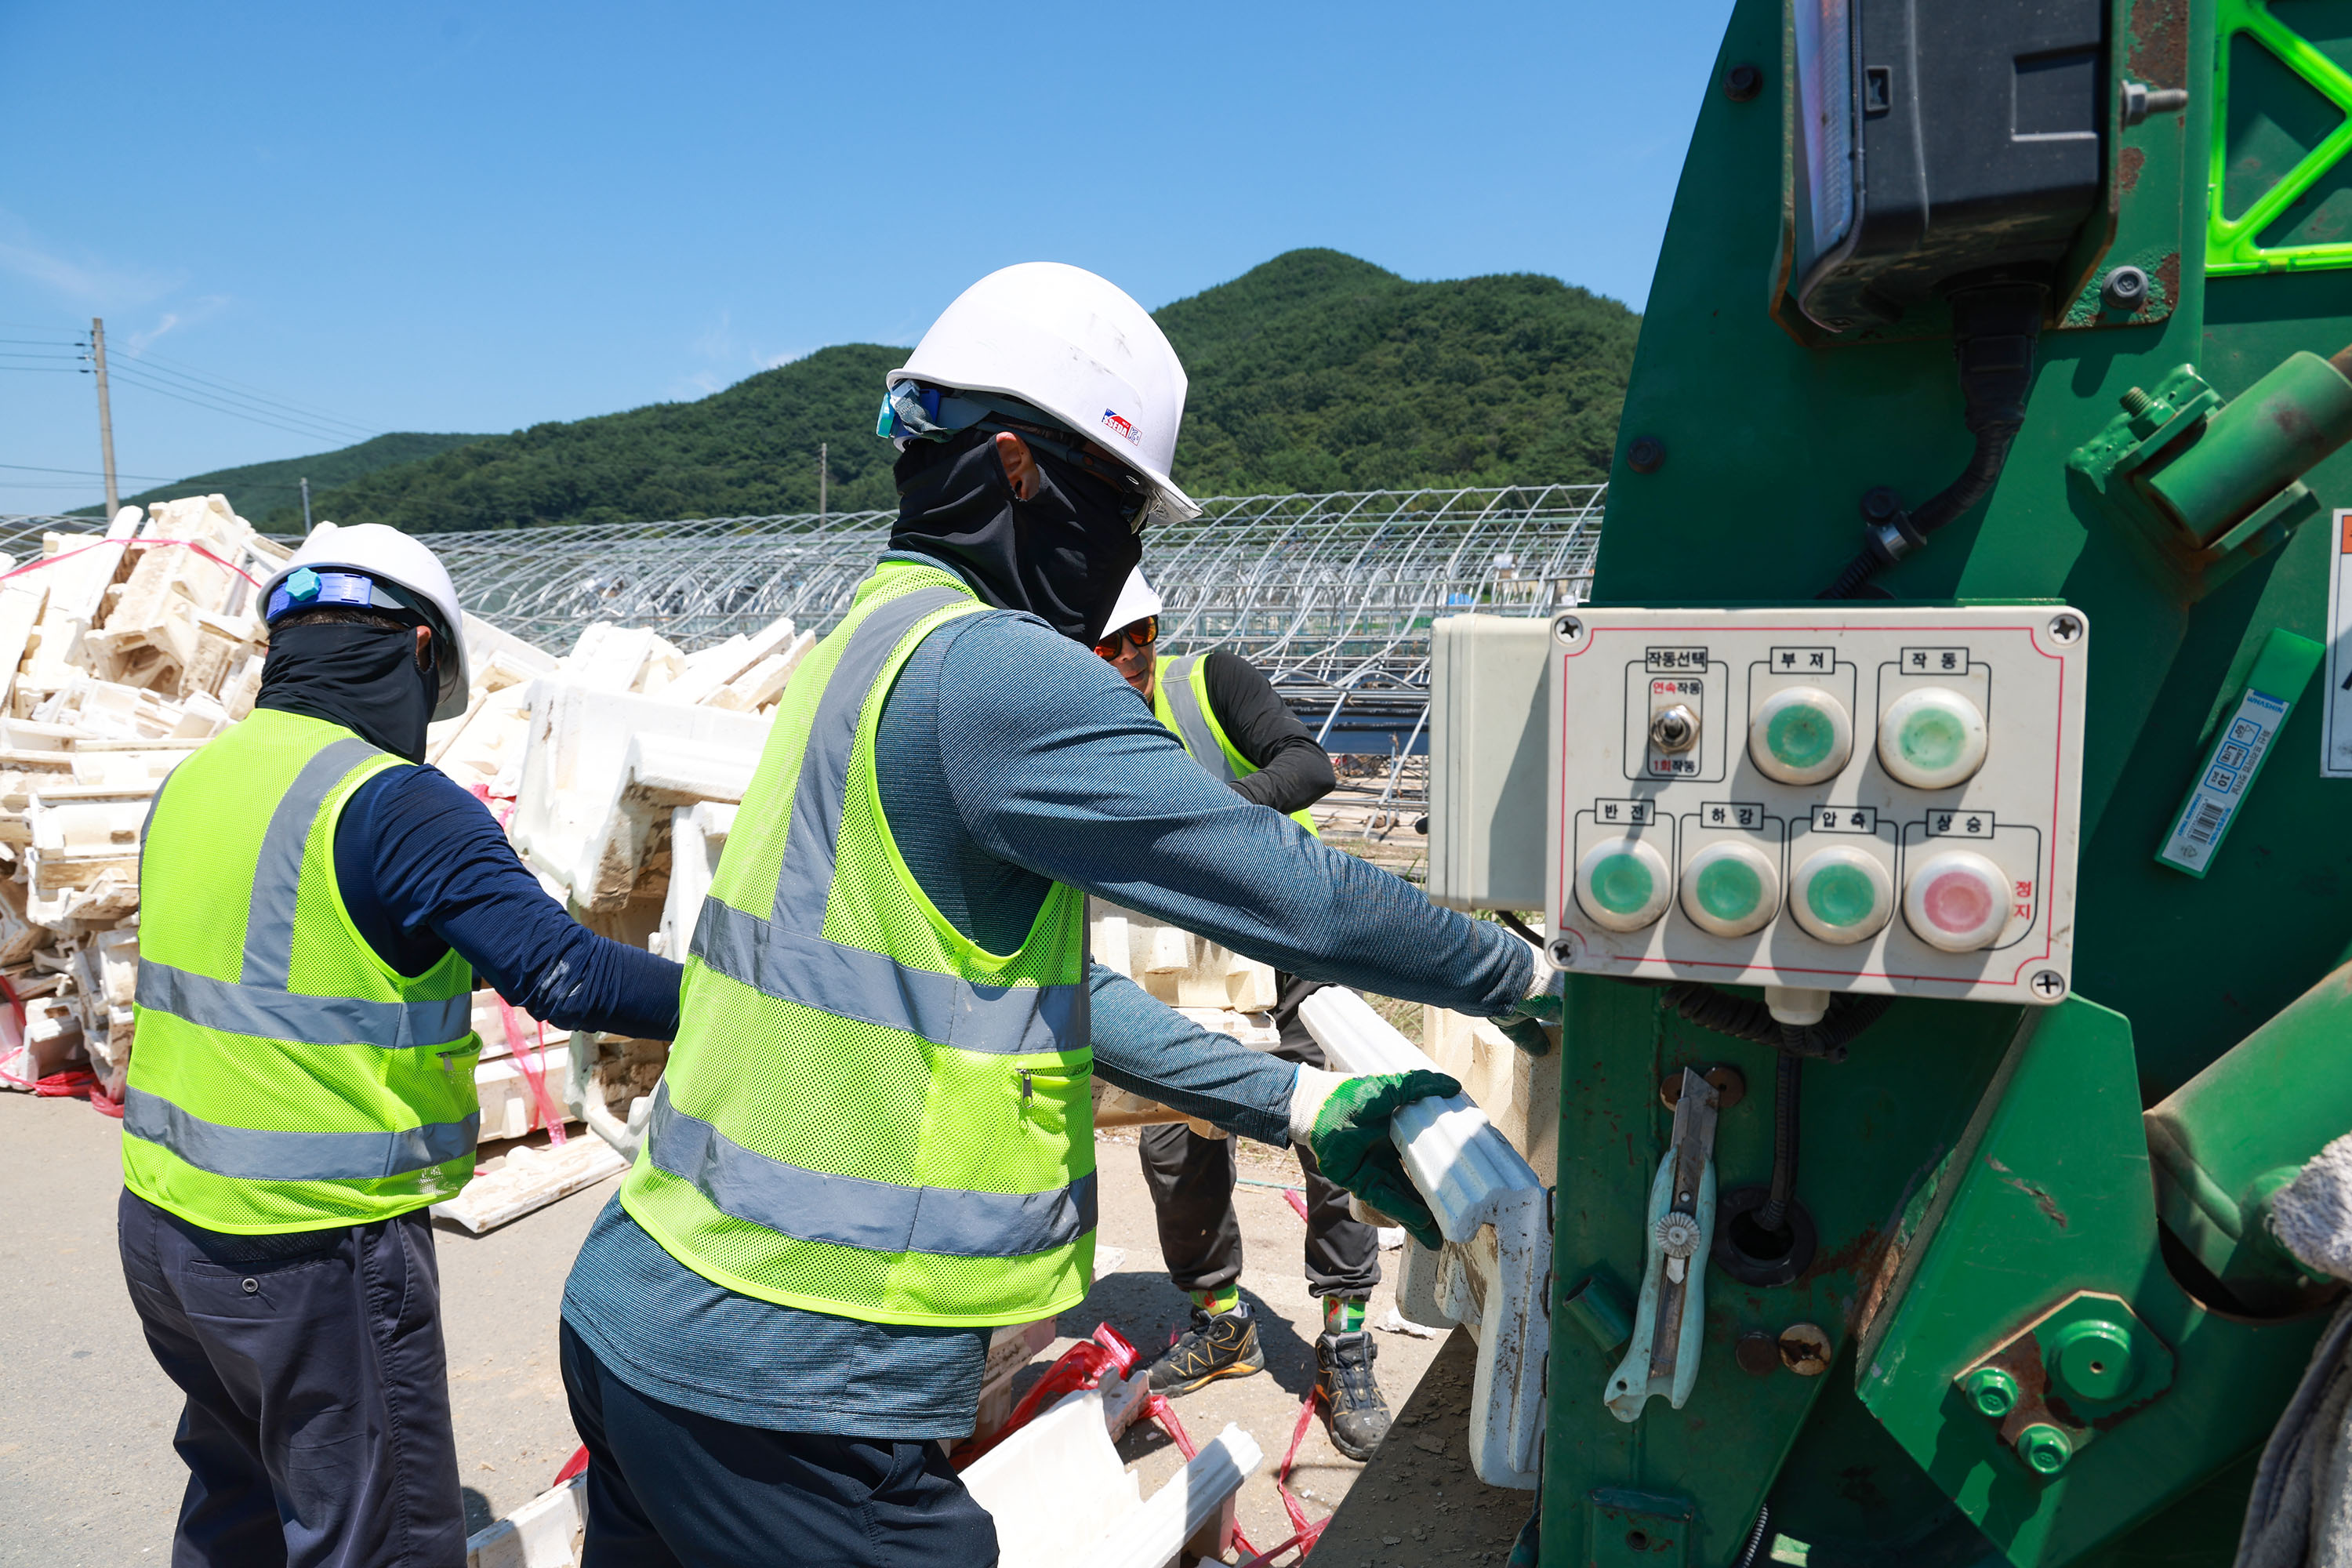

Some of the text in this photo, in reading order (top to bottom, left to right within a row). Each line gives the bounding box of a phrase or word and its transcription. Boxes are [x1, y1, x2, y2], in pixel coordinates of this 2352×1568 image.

[1104, 415, 1128, 437] SSEDA
[1648, 651, 1705, 668] 작동선택
[1912, 652, 1957, 670] 작동
[1653, 681, 1700, 695] 연속작동
[1653, 760, 1695, 772] 1회작동
[2242, 746, 2263, 773] 프리미엄
[2217, 774, 2231, 788] 10
[1604, 804, 1646, 820] 반전
[1711, 808, 1753, 825] 하강
[1822, 811, 1866, 829] 압축
[1937, 814, 1982, 833] 상승
[2013, 880, 2031, 920] 정지
